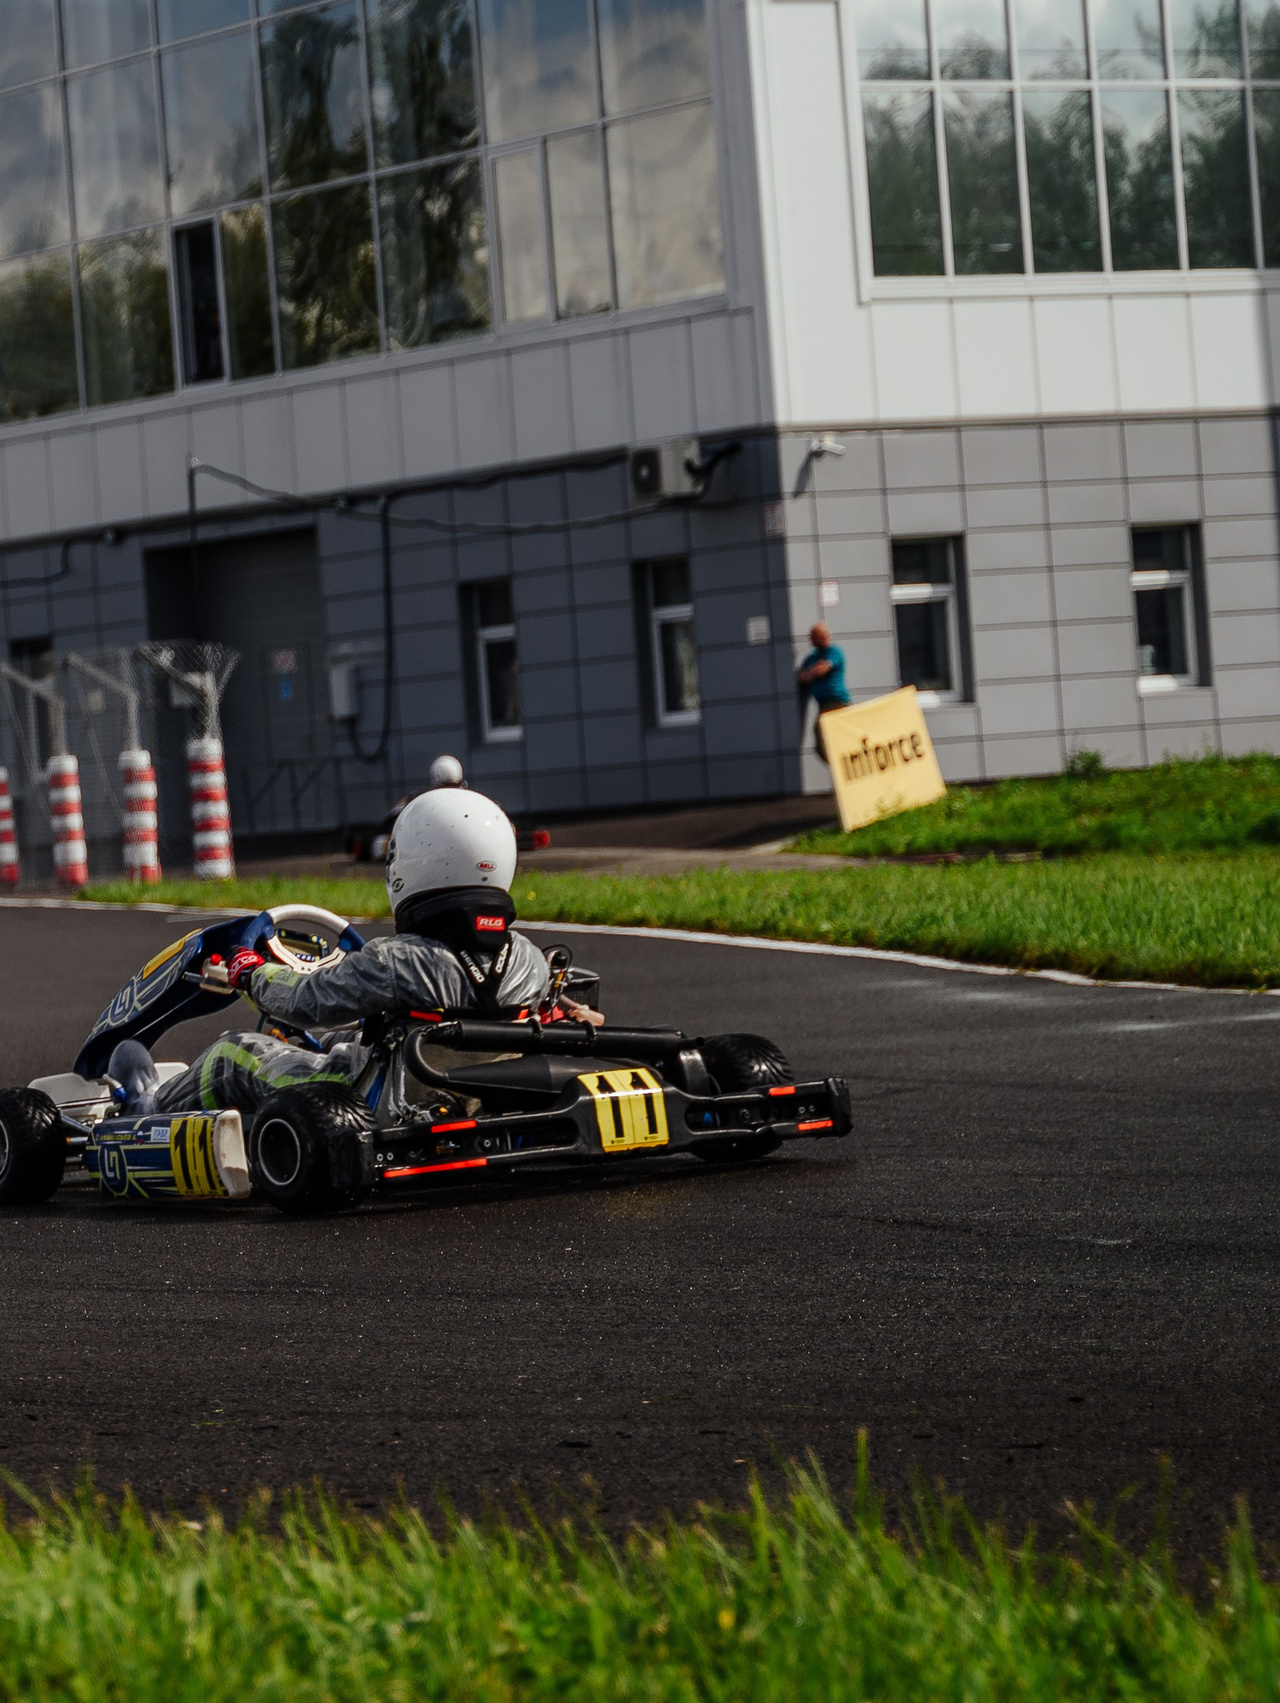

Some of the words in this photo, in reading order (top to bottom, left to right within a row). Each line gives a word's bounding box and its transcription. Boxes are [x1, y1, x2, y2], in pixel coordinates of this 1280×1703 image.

[842, 732, 925, 783] inforce
[596, 1071, 659, 1139] 11
[174, 1119, 217, 1190] 11
